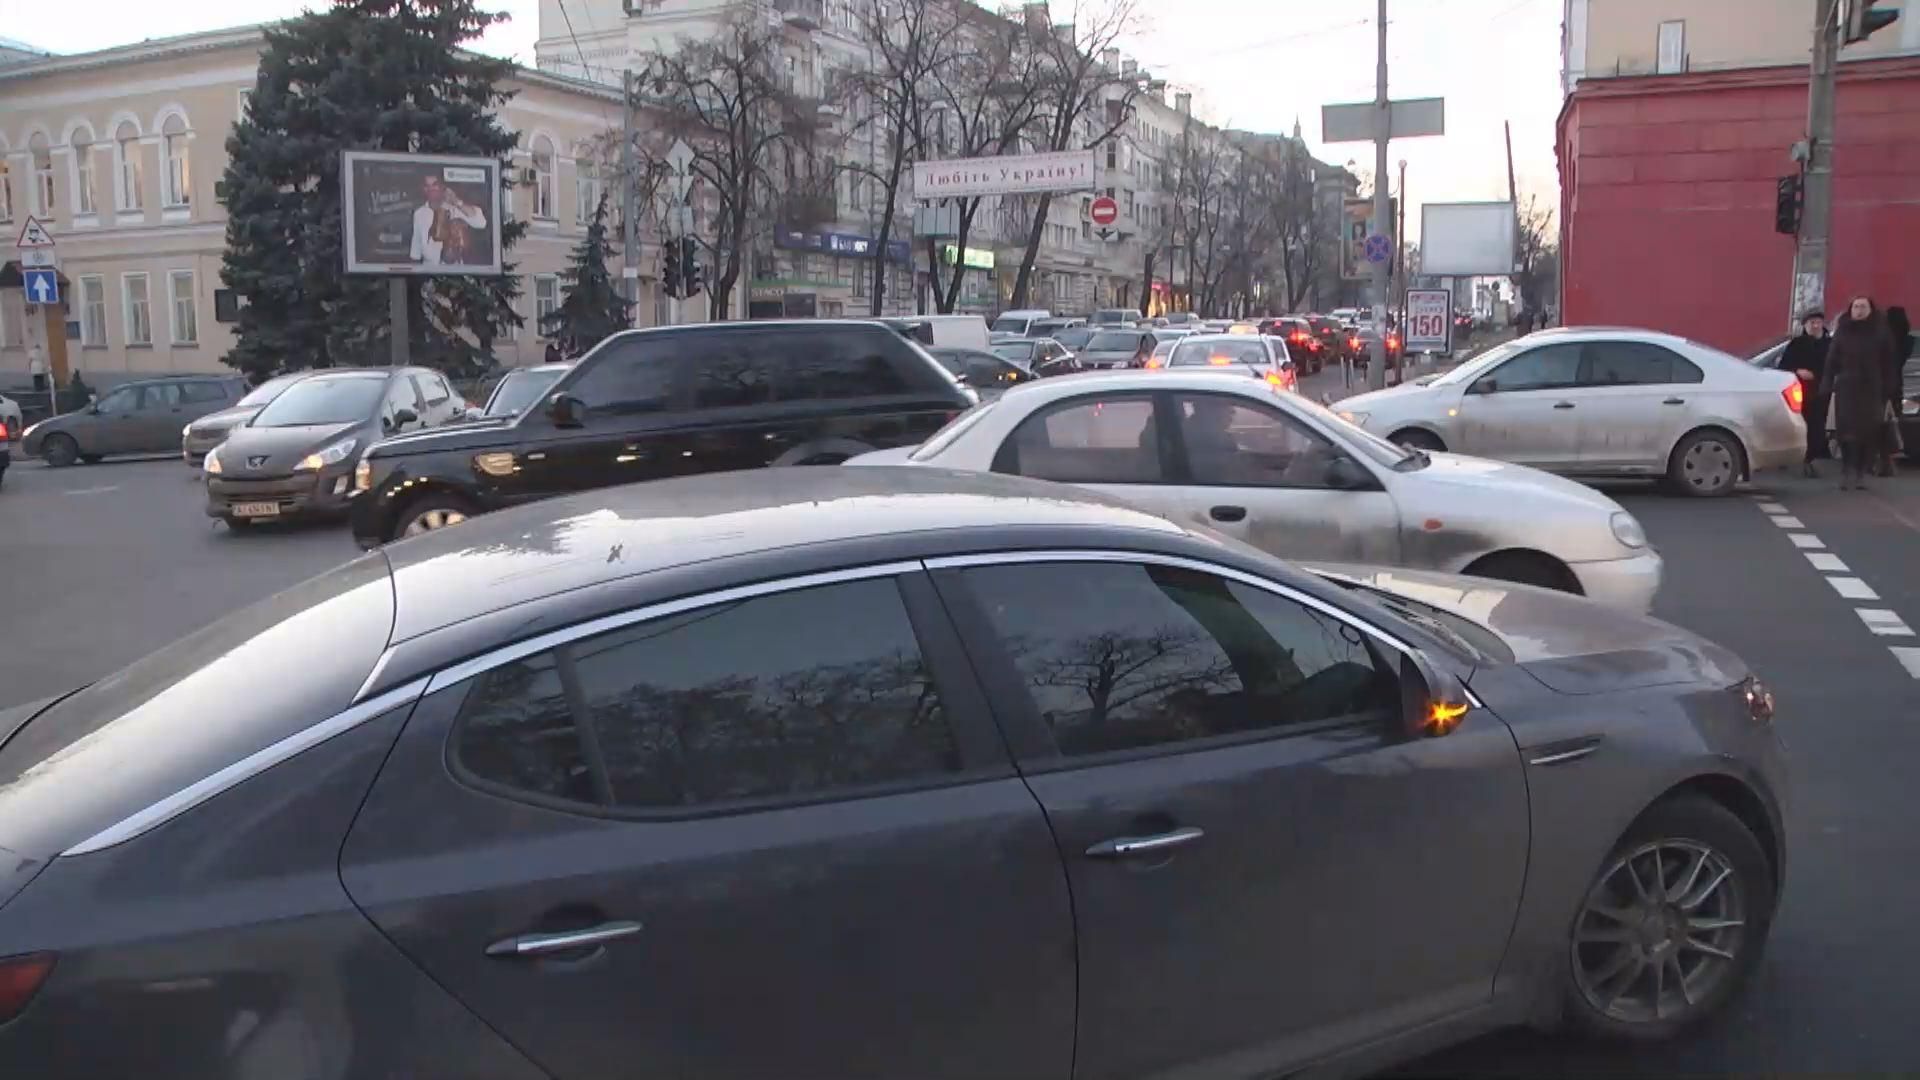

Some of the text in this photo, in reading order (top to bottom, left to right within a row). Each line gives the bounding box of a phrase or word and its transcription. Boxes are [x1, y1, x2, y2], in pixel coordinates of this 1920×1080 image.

[925, 163, 1084, 186] Любіть Україну!
[1410, 315, 1443, 337] 150
